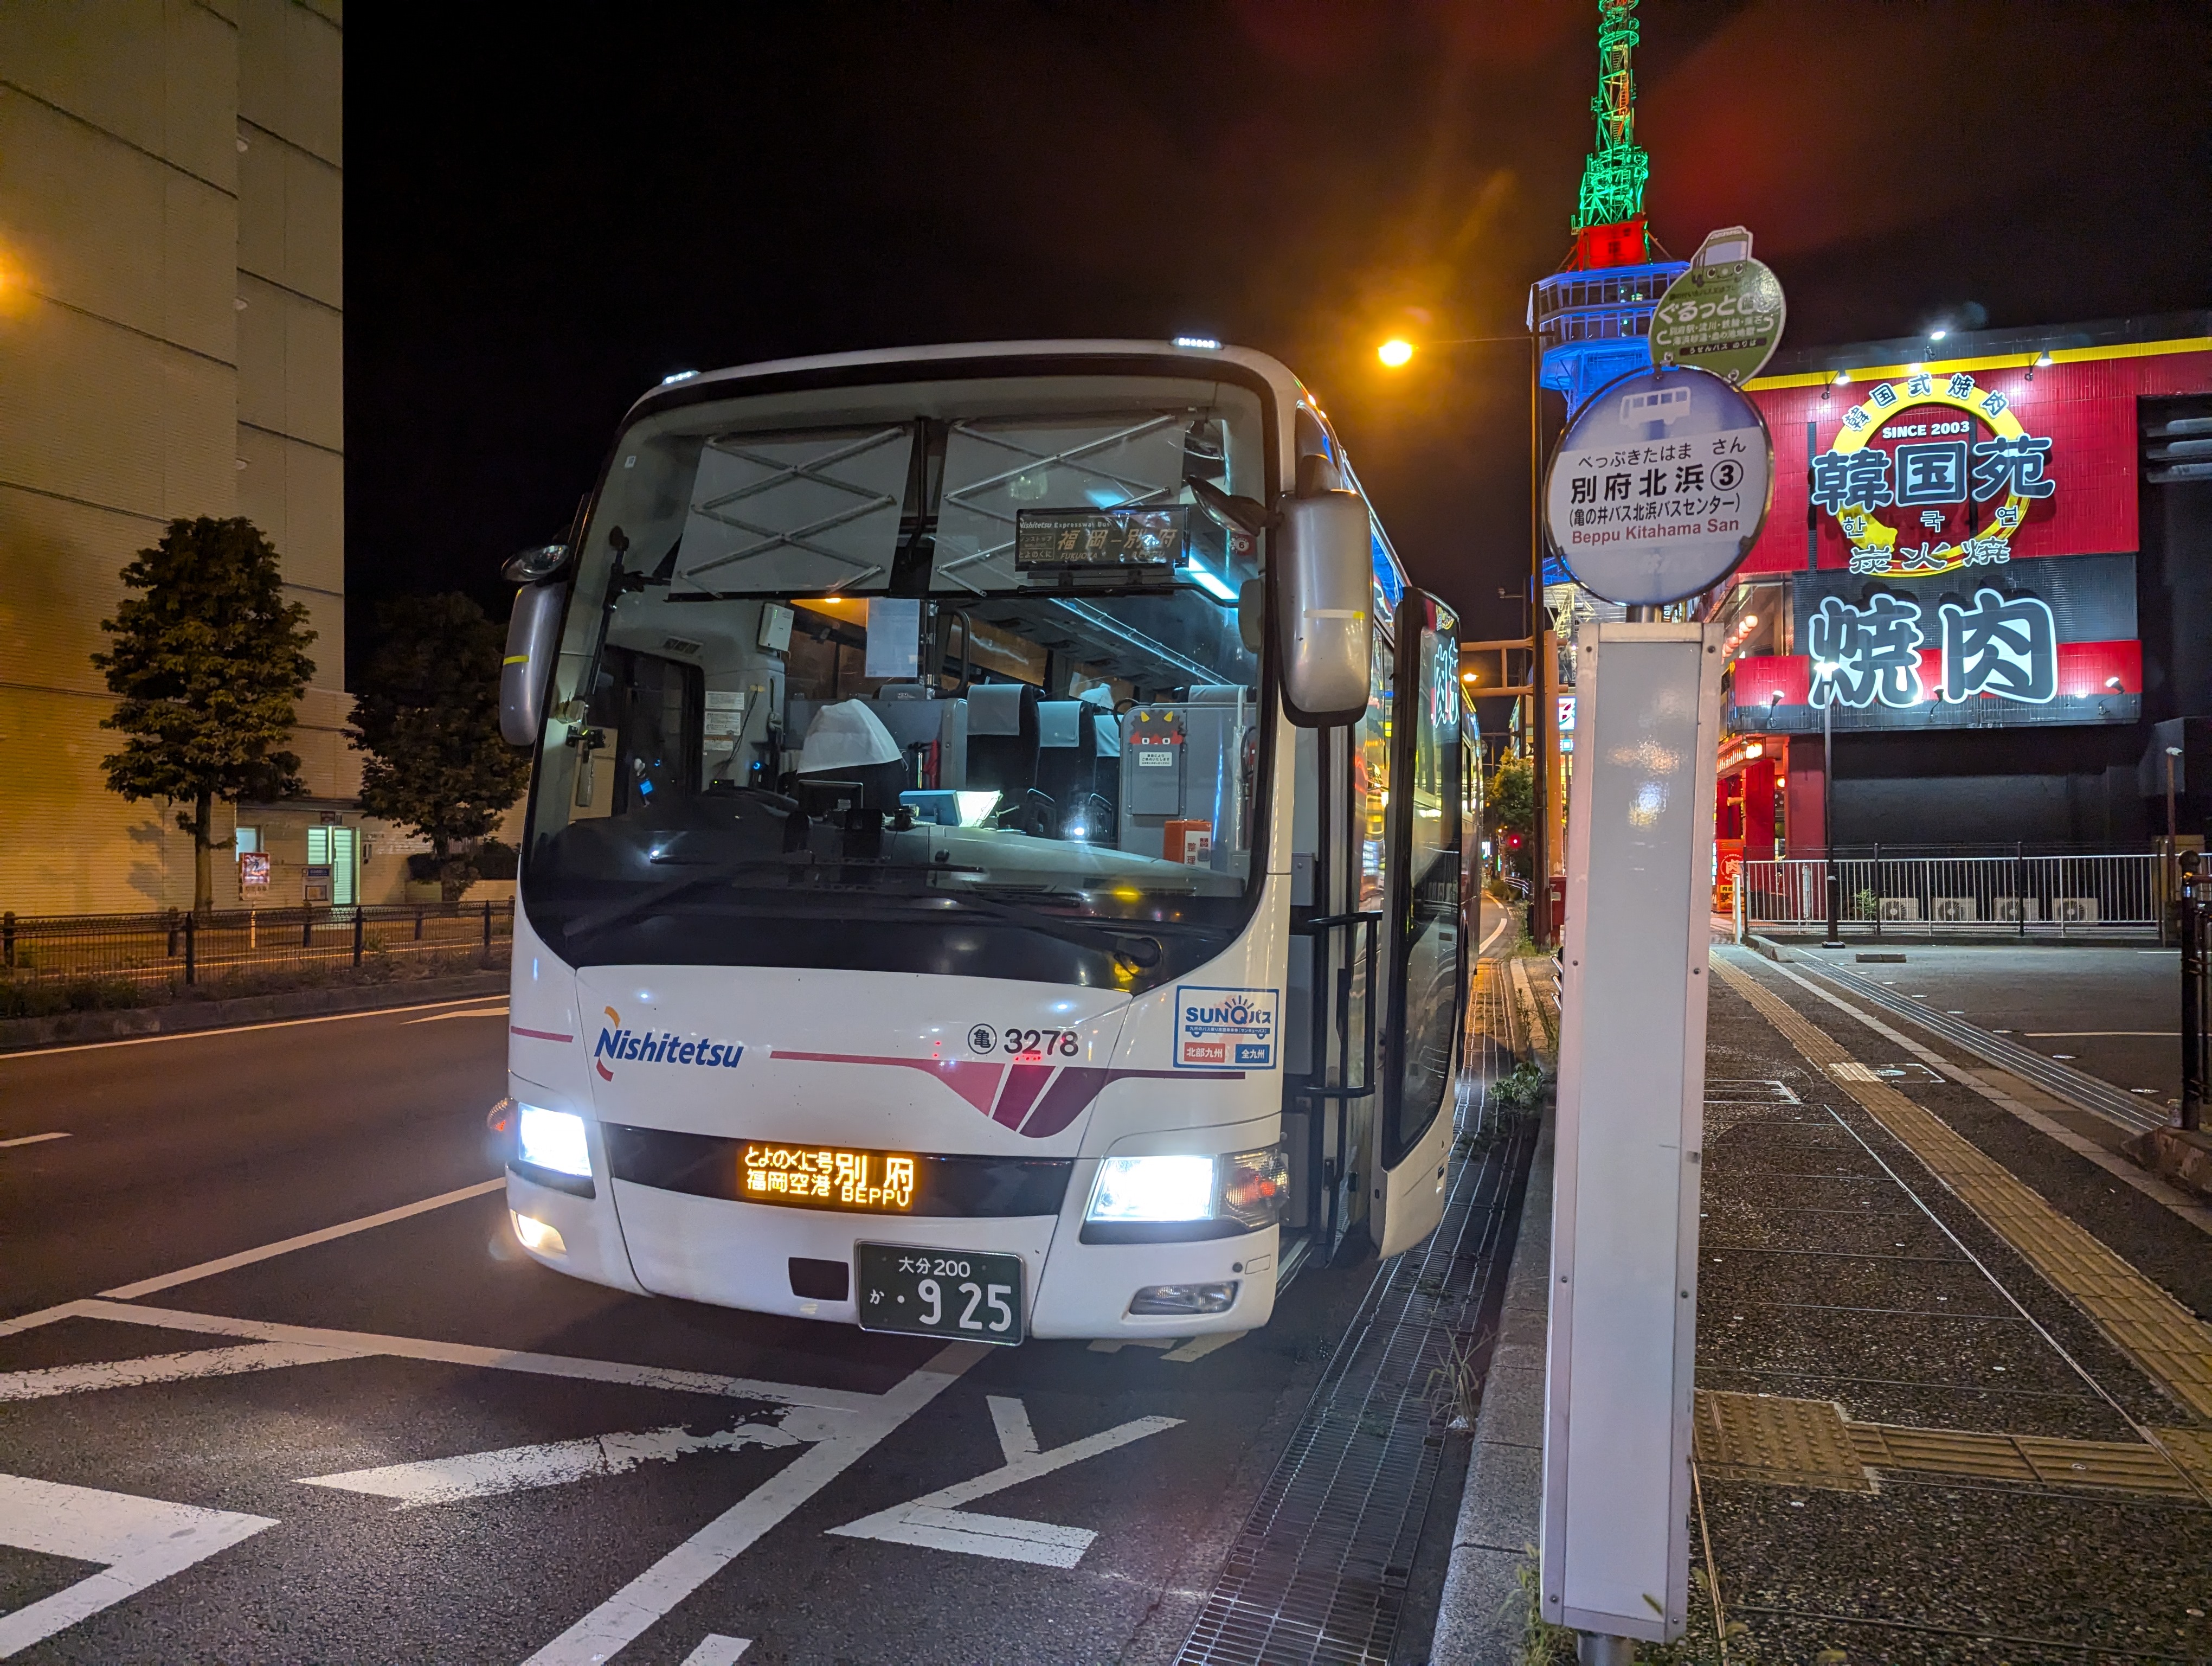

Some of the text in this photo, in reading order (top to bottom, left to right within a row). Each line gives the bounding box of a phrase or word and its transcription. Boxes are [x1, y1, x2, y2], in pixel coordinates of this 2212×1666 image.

[1842, 372, 2009, 432] 韓国式焼肉
[1882, 421, 1970, 439] SINCE 2003
[1578, 436, 1746, 468] べっぷきたはま さん
[1811, 434, 2055, 516] 韓国苑
[1569, 492, 1740, 528] (亀の井バス北浜バスセンター)
[1572, 518, 1739, 546] Beppu Kitahama San
[1019, 550, 1052, 559] とよのくに
[1849, 537, 2010, 574] 炭火焼
[1808, 588, 2058, 709] 焼肉
[594, 1026, 743, 1069] Nishitetsu
[1004, 1028, 1079, 1056] 3278
[1186, 1047, 1223, 1058] 北部九州
[1241, 1049, 1265, 1059] 全九州
[744, 1146, 834, 1174] とよのくに号
[834, 1153, 914, 1192] 別府
[747, 1168, 831, 1197] 福岡空港
[841, 1185, 910, 1207] BEPPU
[870, 1289, 885, 1305] か
